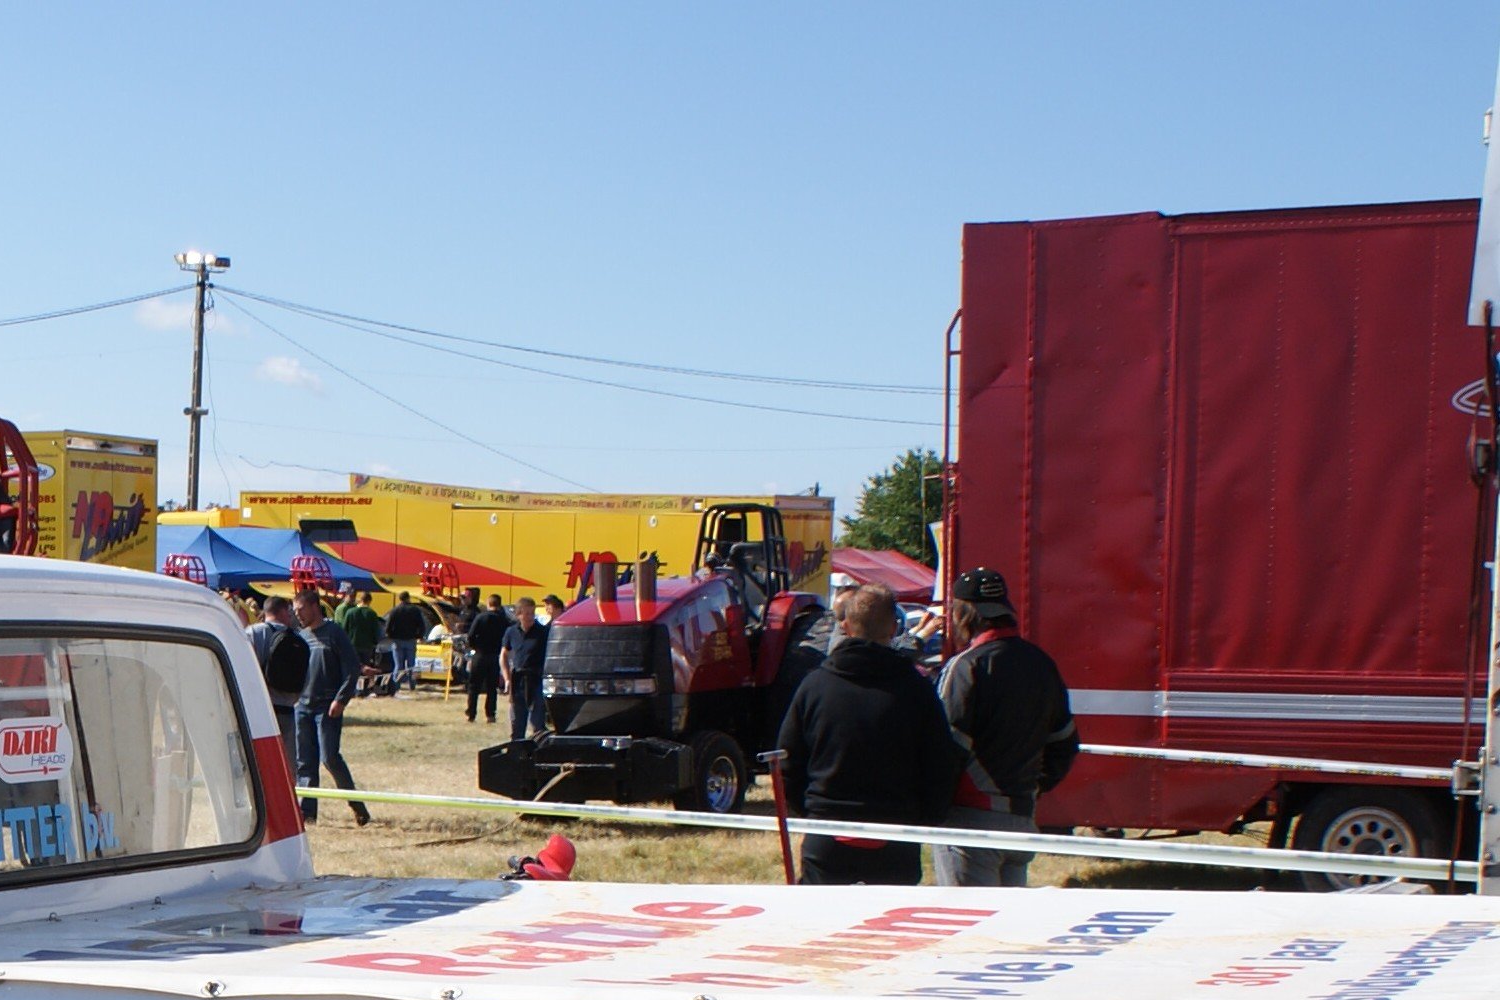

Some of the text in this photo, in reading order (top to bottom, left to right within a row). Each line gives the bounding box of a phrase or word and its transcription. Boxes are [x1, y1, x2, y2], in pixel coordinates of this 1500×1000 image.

[249, 495, 372, 505] www.nolimitteam.eu
[3, 723, 63, 757] DART
[31, 753, 66, 767] HEADS
[301, 901, 765, 977] Rattle
